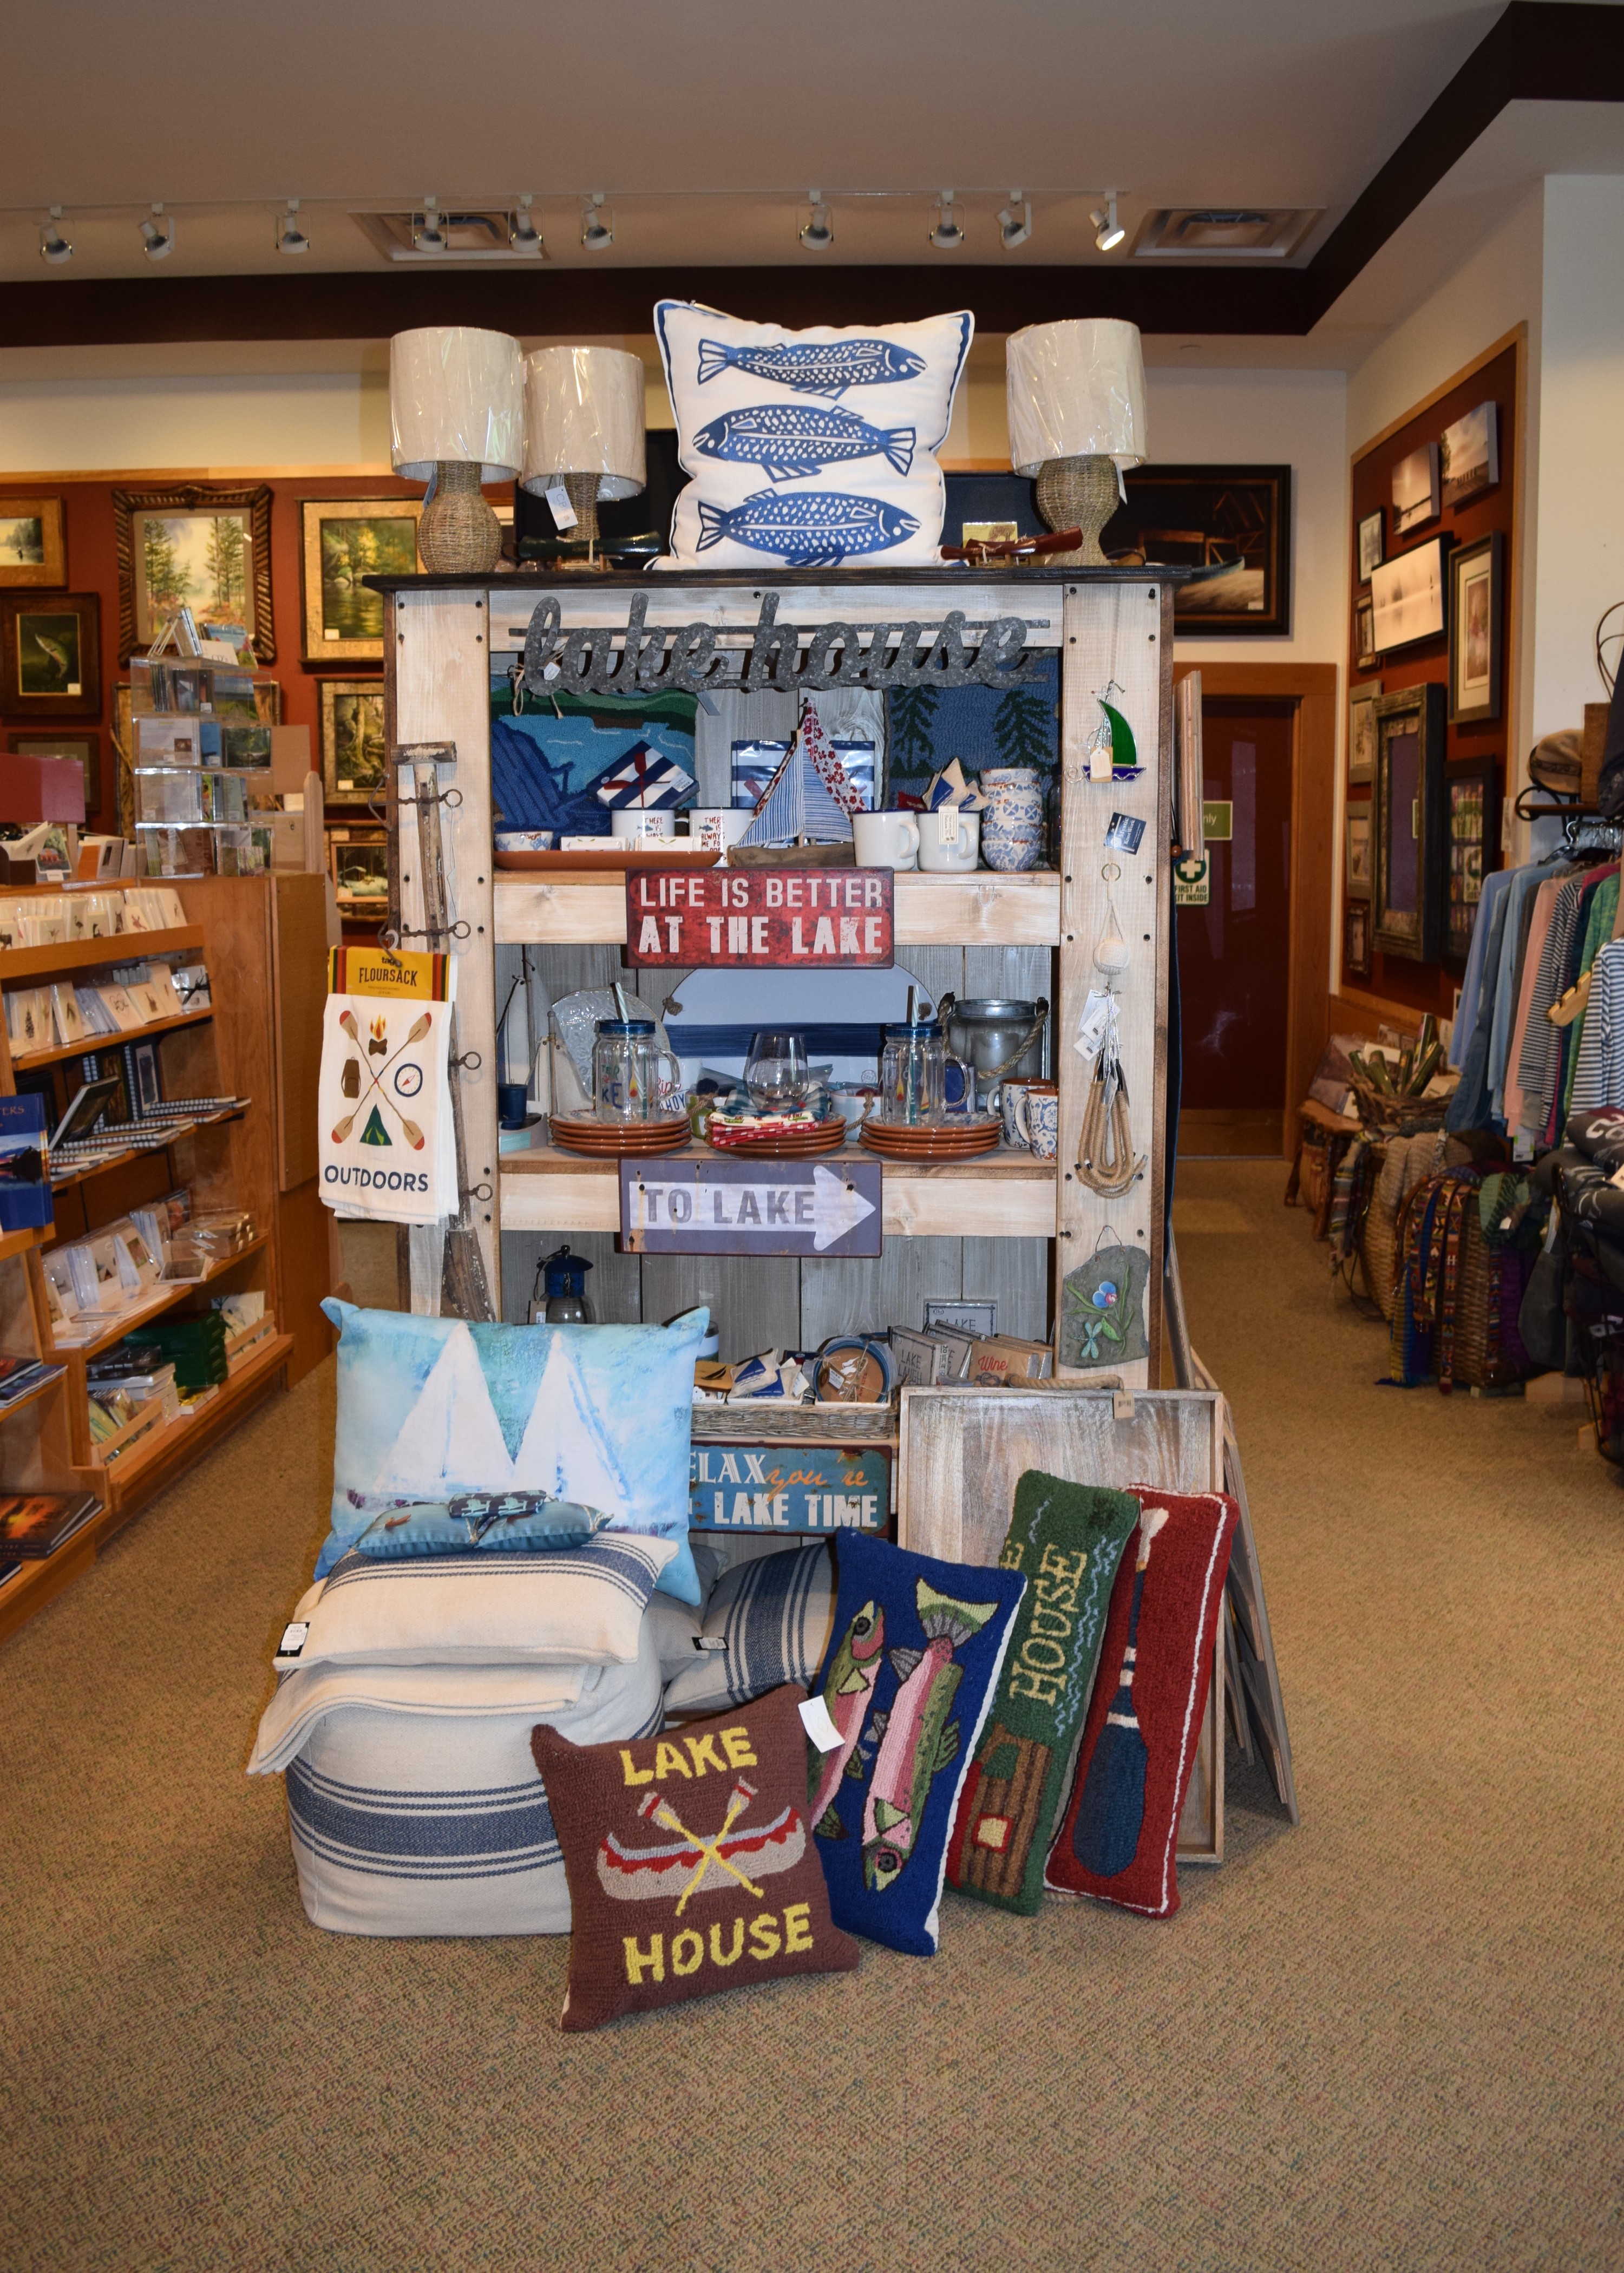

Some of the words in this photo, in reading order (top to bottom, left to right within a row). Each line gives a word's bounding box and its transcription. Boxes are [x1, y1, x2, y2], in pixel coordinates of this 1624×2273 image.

[523, 592, 730, 696] lake
[746, 592, 1040, 693] house
[1118, 817, 1129, 837] Mystic
[1203, 813, 1216, 826] nly
[640, 878, 704, 907] LIFE
[722, 878, 749, 908] IS
[767, 879, 882, 907] BETTER
[1186, 894, 1208, 902] INSIDE
[1195, 885, 1207, 893] AID
[638, 916, 683, 953] AT
[706, 916, 769, 954] THE
[792, 916, 882, 954] LAKE
[359, 967, 418, 987] FLOURSACK
[0, 1106, 25, 1116] ERS
[325, 1165, 428, 1192] OUTDOORS
[644, 1188, 692, 1224] TO
[713, 1190, 815, 1225] LAKE
[901, 1350, 921, 1370] LAKE
[978, 1355, 1007, 1371] Wine
[690, 1450, 767, 1484] ELAX
[714, 1491, 789, 1525] LAKE
[804, 1494, 878, 1528] TIME
[1009, 1543, 1088, 1707] HOUSE
[619, 1726, 758, 1786] LAKE
[623, 1902, 814, 1984] HOUSE
